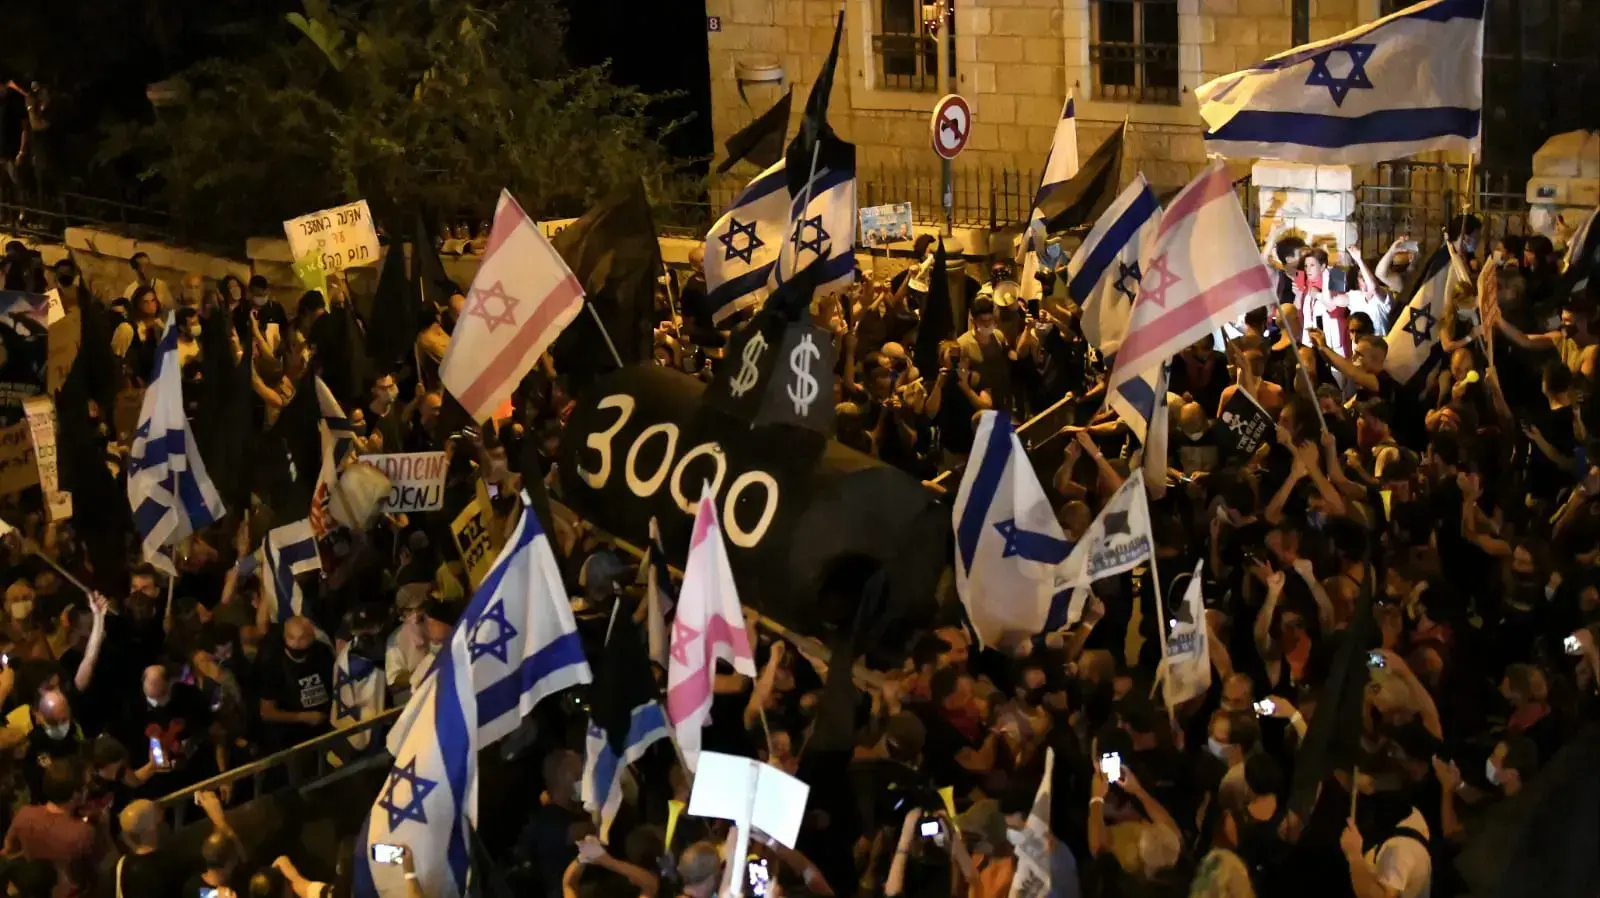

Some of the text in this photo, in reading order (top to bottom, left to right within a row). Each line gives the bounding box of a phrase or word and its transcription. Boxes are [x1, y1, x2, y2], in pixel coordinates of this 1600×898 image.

[710, 17, 718, 30] 8
[321, 252, 342, 270] ההל
[577, 394, 779, 548] 3000
[387, 485, 440, 509] נמאס
